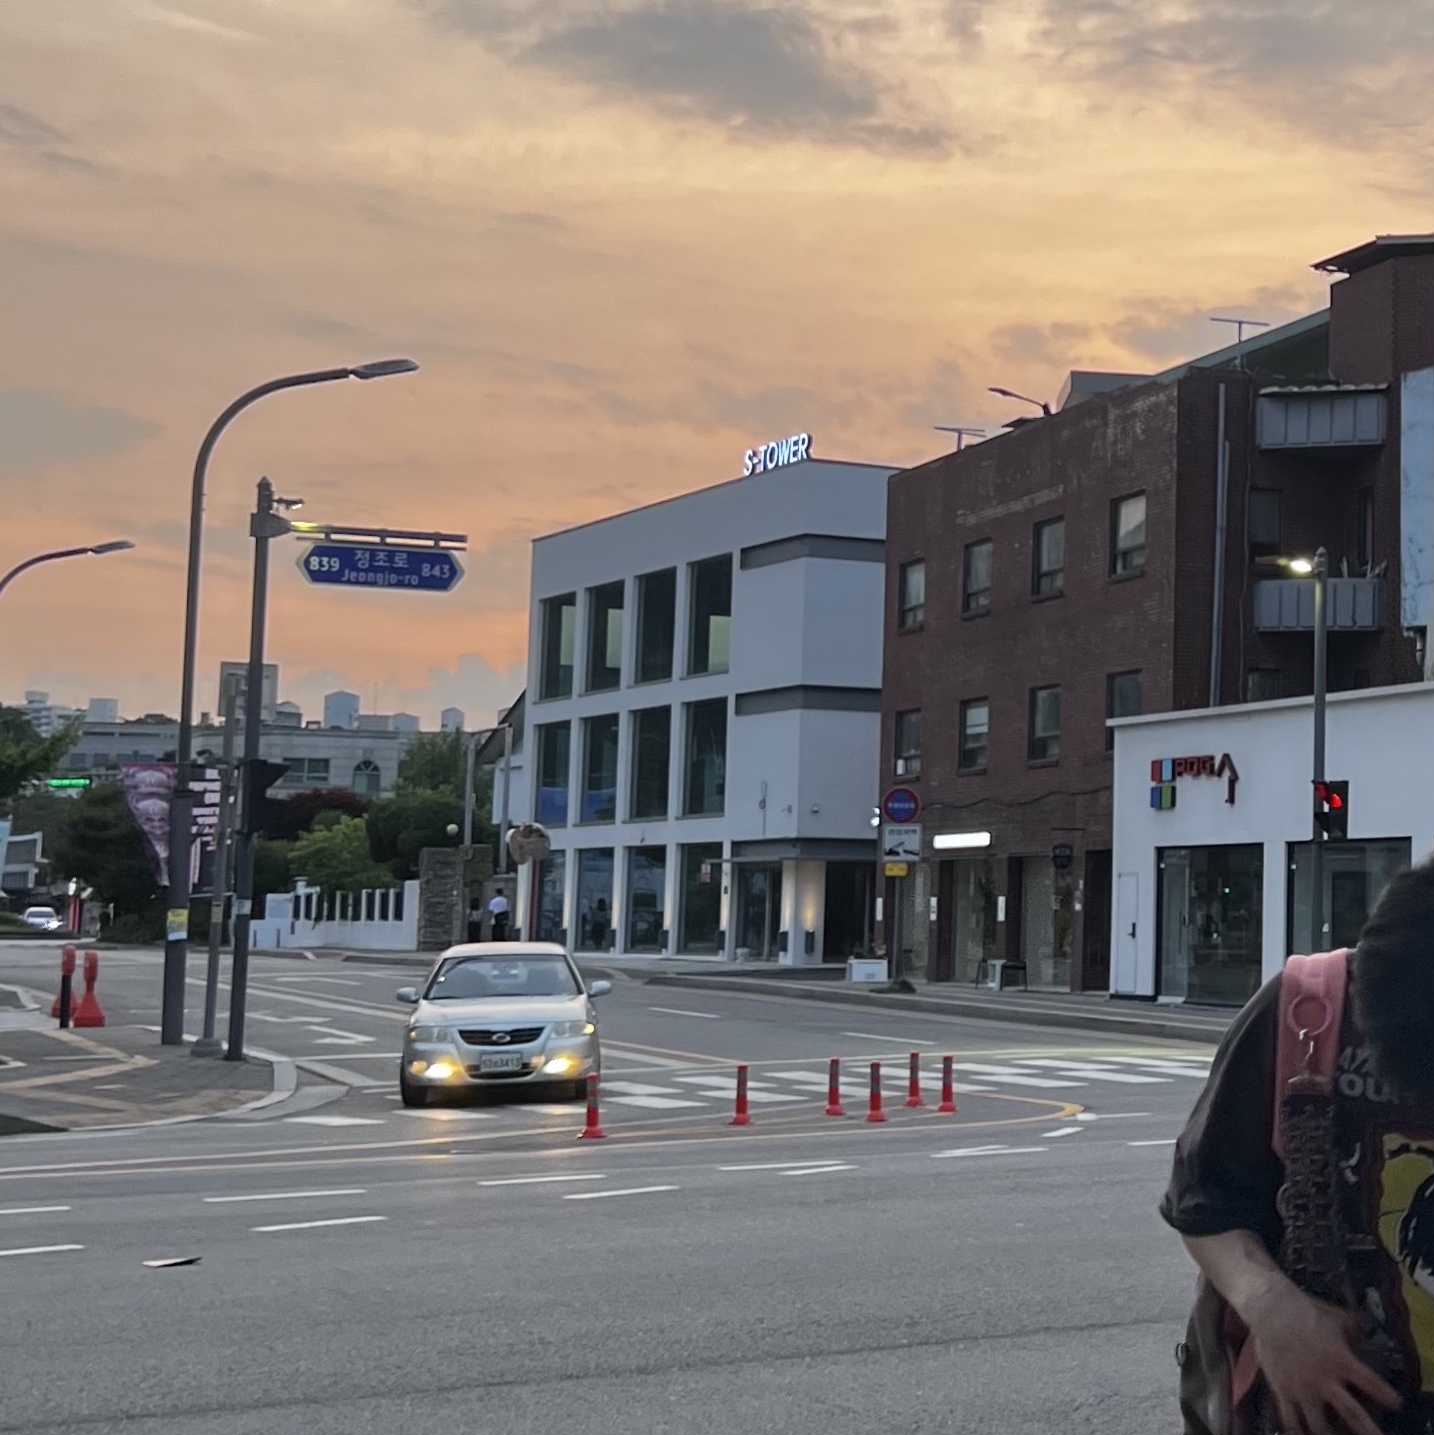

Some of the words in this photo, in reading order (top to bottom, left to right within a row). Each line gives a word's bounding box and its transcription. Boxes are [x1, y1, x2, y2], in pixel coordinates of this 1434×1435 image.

[743, 433, 809, 476] S-TOWER
[309, 556, 340, 571] 839
[354, 550, 409, 569] 정조로
[341, 569, 419, 585] Jeongjo-ro
[421, 563, 450, 578] 843
